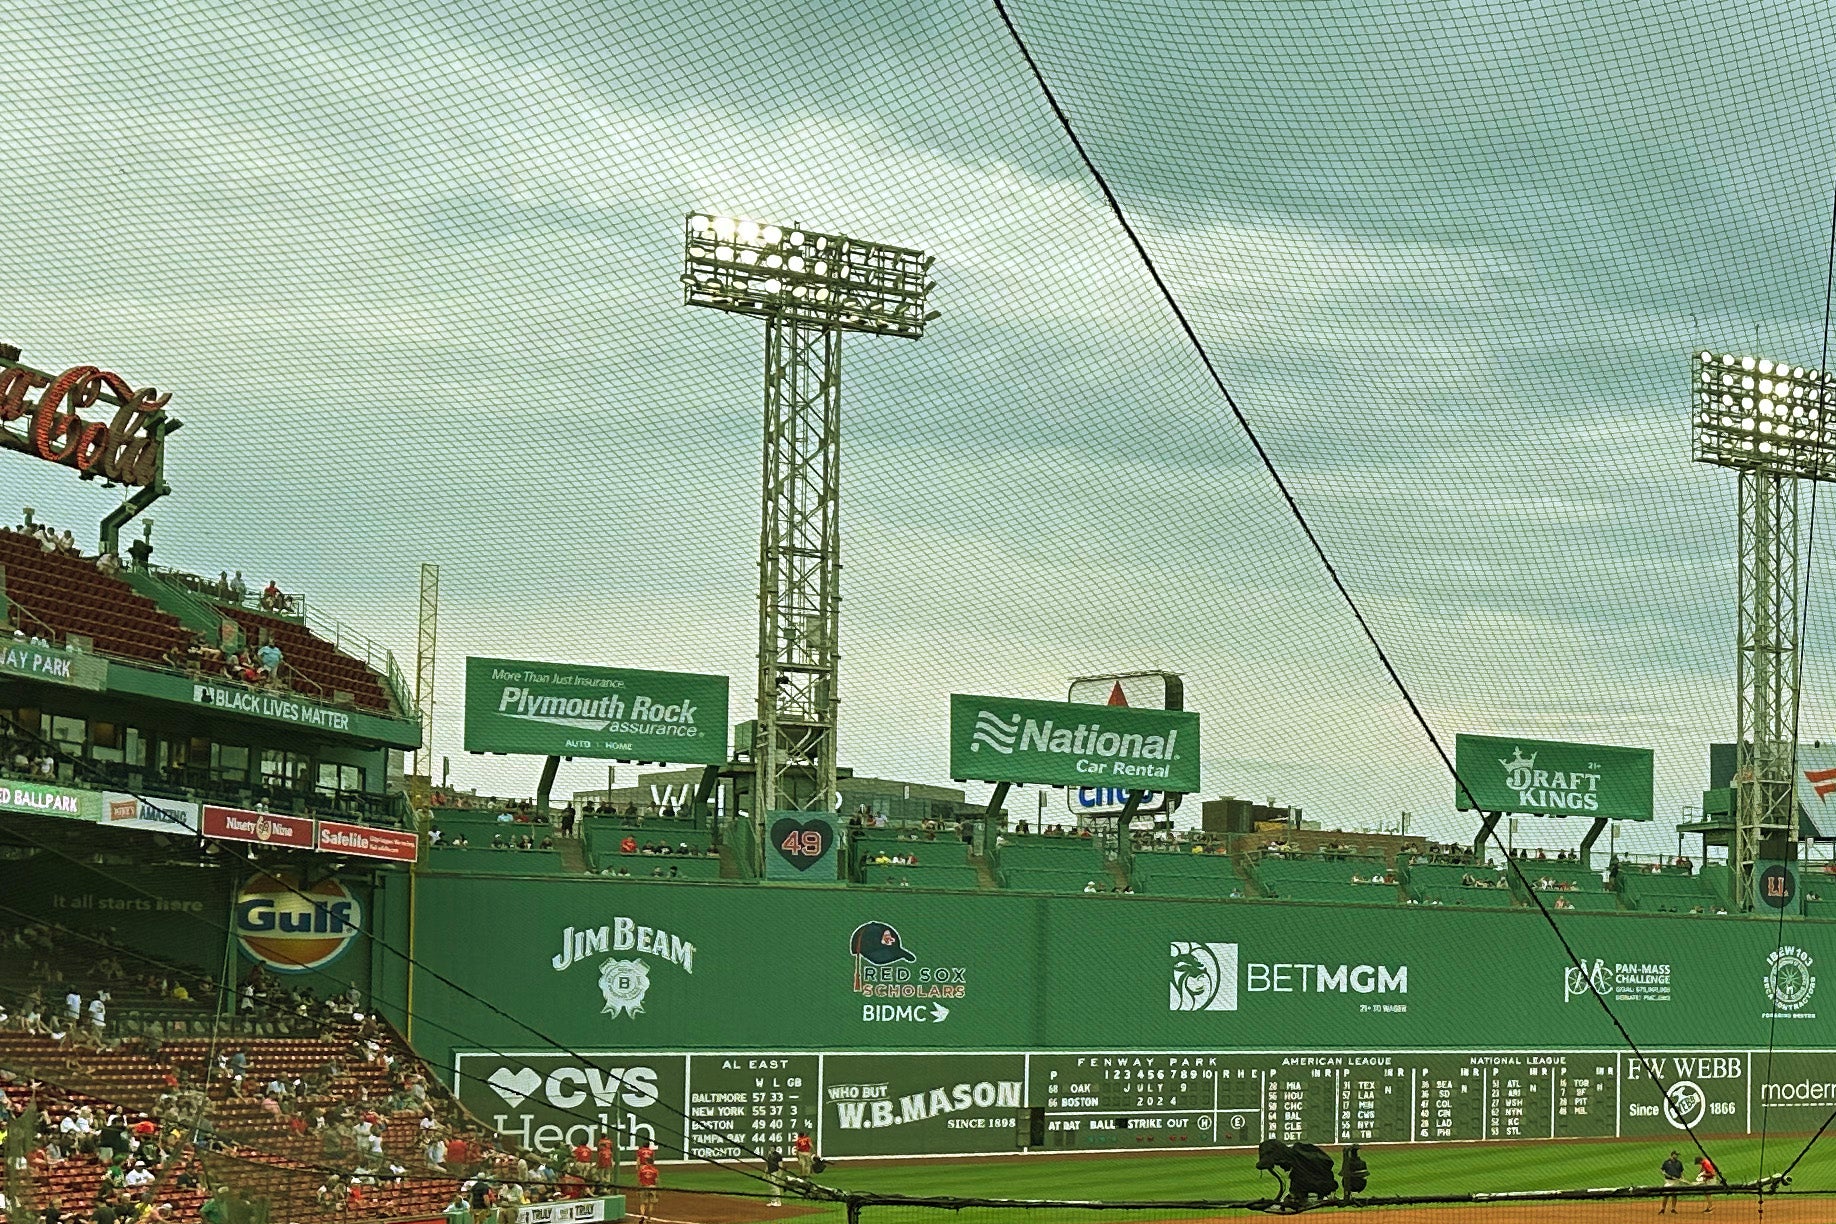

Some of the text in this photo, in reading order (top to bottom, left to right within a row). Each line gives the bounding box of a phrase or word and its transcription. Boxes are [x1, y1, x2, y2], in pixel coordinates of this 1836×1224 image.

[33, 654, 71, 678] PARK
[491, 669, 521, 681] More
[523, 671, 550, 683] Than
[551, 674, 573, 685] Just
[215, 690, 349, 730] BLACK LIVES MATTER
[499, 686, 698, 724] Plymouth Rock
[609, 719, 698, 737] assurance
[565, 739, 632, 751] AUTO HOME
[1019, 717, 1178, 760] National
[1076, 759, 1170, 778] Car Rental
[1506, 766, 1600, 791] DRAFT
[14, 789, 78, 813] BALLPARK
[1519, 788, 1599, 811] KINGS
[321, 828, 369, 849] Safelite
[781, 831, 823, 856] 49
[97, 897, 151, 912] starts
[238, 898, 351, 934] Gulf
[552, 916, 695, 975] JIM BEAM
[1766, 945, 1813, 967] IBEW 103
[863, 967, 967, 983] RED SOX
[1615, 963, 1671, 975] PAN-MASS
[1247, 963, 1408, 993] BETMGM
[1615, 974, 1671, 985] CHALLENGE
[862, 983, 966, 998] SCHOLARS
[863, 1005, 927, 1022] BIDMC
[722, 1060, 788, 1070] AL EAST
[1077, 1058, 1217, 1067] FENWAY PARK
[1281, 1057, 1392, 1066] AMERICAN LEAGUE
[1470, 1056, 1567, 1065] NATIONAL LEAGUE
[1673, 1057, 1741, 1079] WEBB
[545, 1067, 659, 1108] CVS
[827, 1085, 888, 1100] WHO BUT
[1070, 1084, 1091, 1093] OAK
[691, 1092, 748, 1103] BALTIMORE
[1061, 1098, 1099, 1107] BOSTON
[691, 1106, 745, 1117] NEW YORK
[1629, 1102, 1659, 1117] Since
[1709, 1102, 1736, 1115] 1866
[692, 1120, 734, 1130] BOSTON
[947, 1118, 1016, 1128] SINCE 1898
[1127, 1118, 1189, 1129] STRIKE OUT
[494, 1113, 659, 1152] Health
[692, 1133, 746, 1144] TAMPA BAY
[691, 1147, 741, 1158] TORONTO
